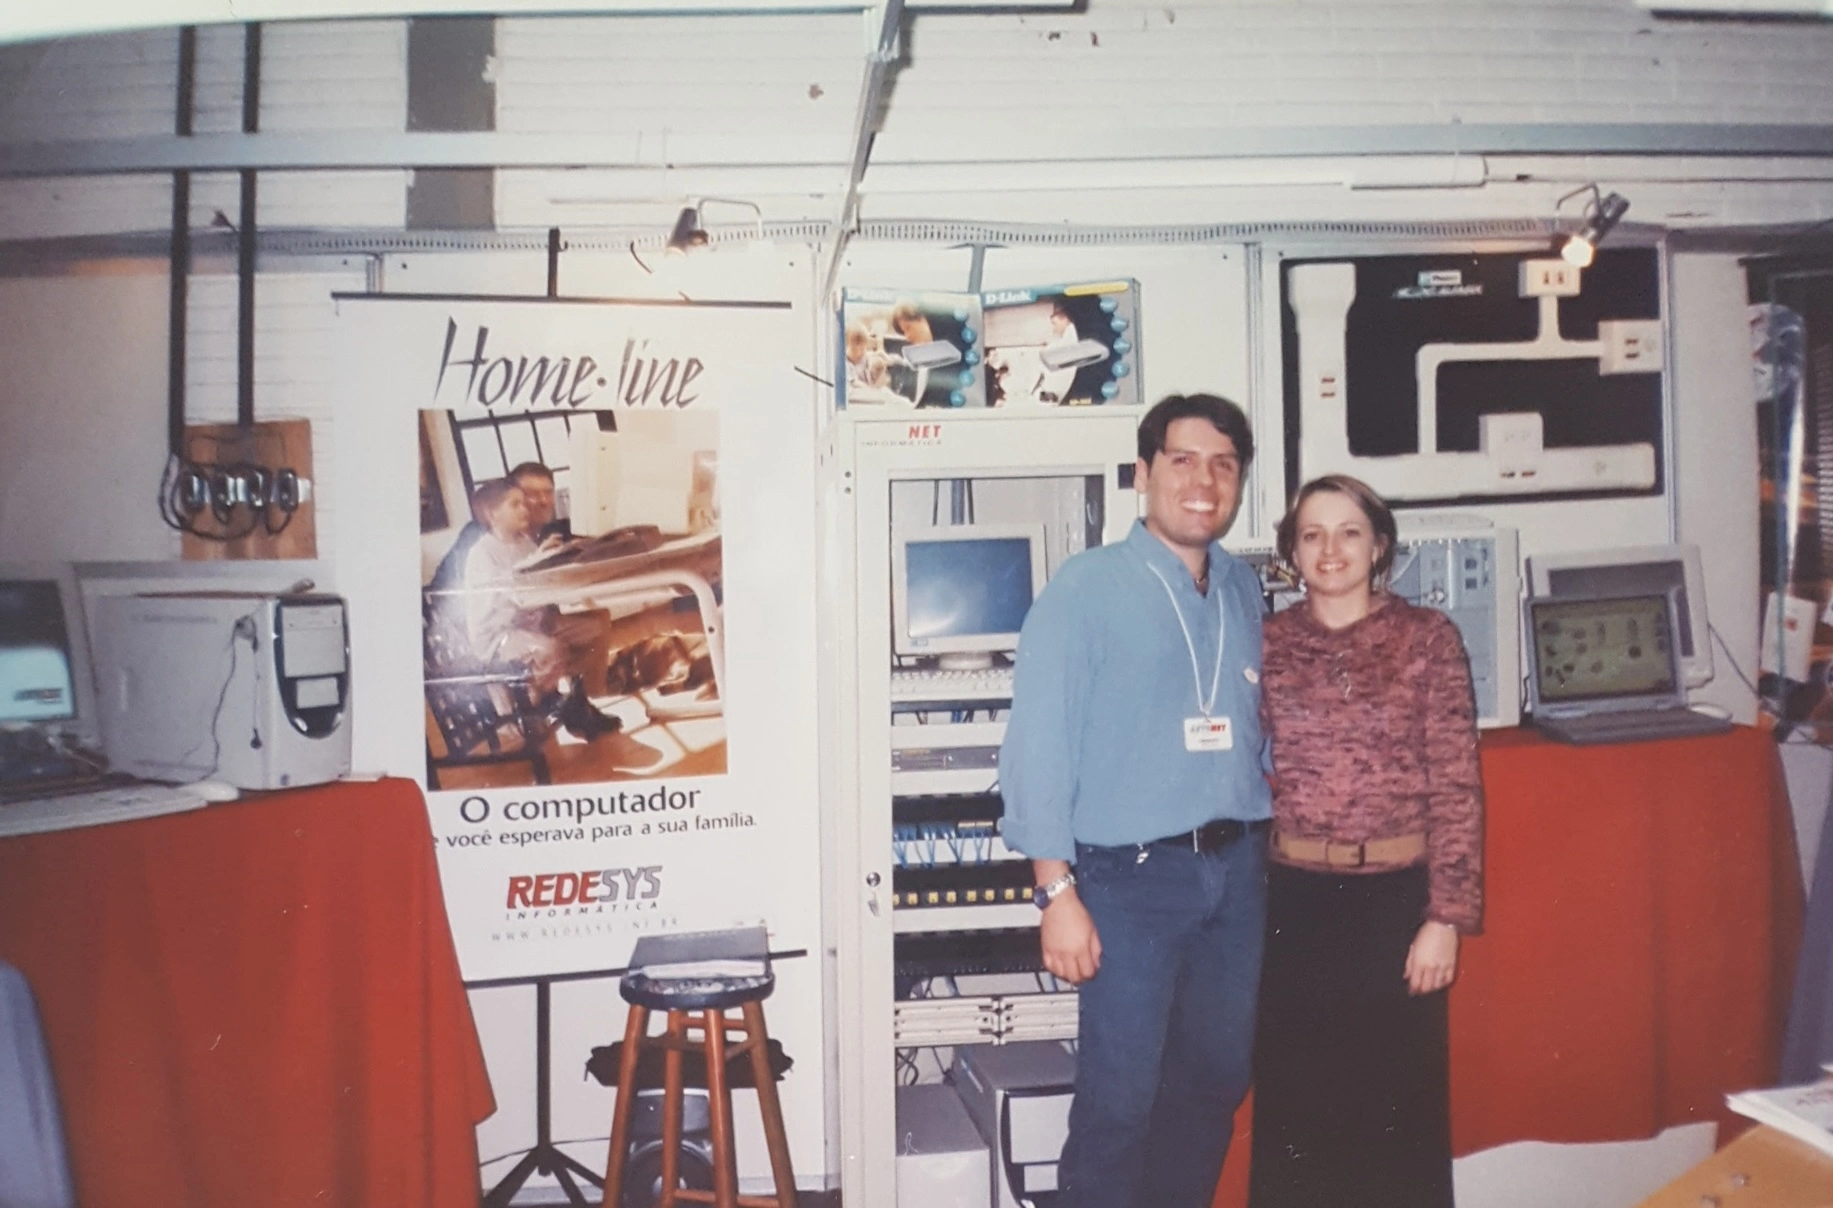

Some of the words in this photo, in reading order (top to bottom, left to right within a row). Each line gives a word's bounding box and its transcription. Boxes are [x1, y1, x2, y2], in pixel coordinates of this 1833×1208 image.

[908, 425, 942, 439] NET
[459, 796, 490, 824] O
[503, 786, 702, 824] computador
[446, 829, 493, 848] você
[499, 827, 585, 847] esperava
[591, 824, 632, 842] para
[641, 823, 652, 835] a
[658, 819, 689, 834] sua
[506, 865, 663, 910] REDESYS
